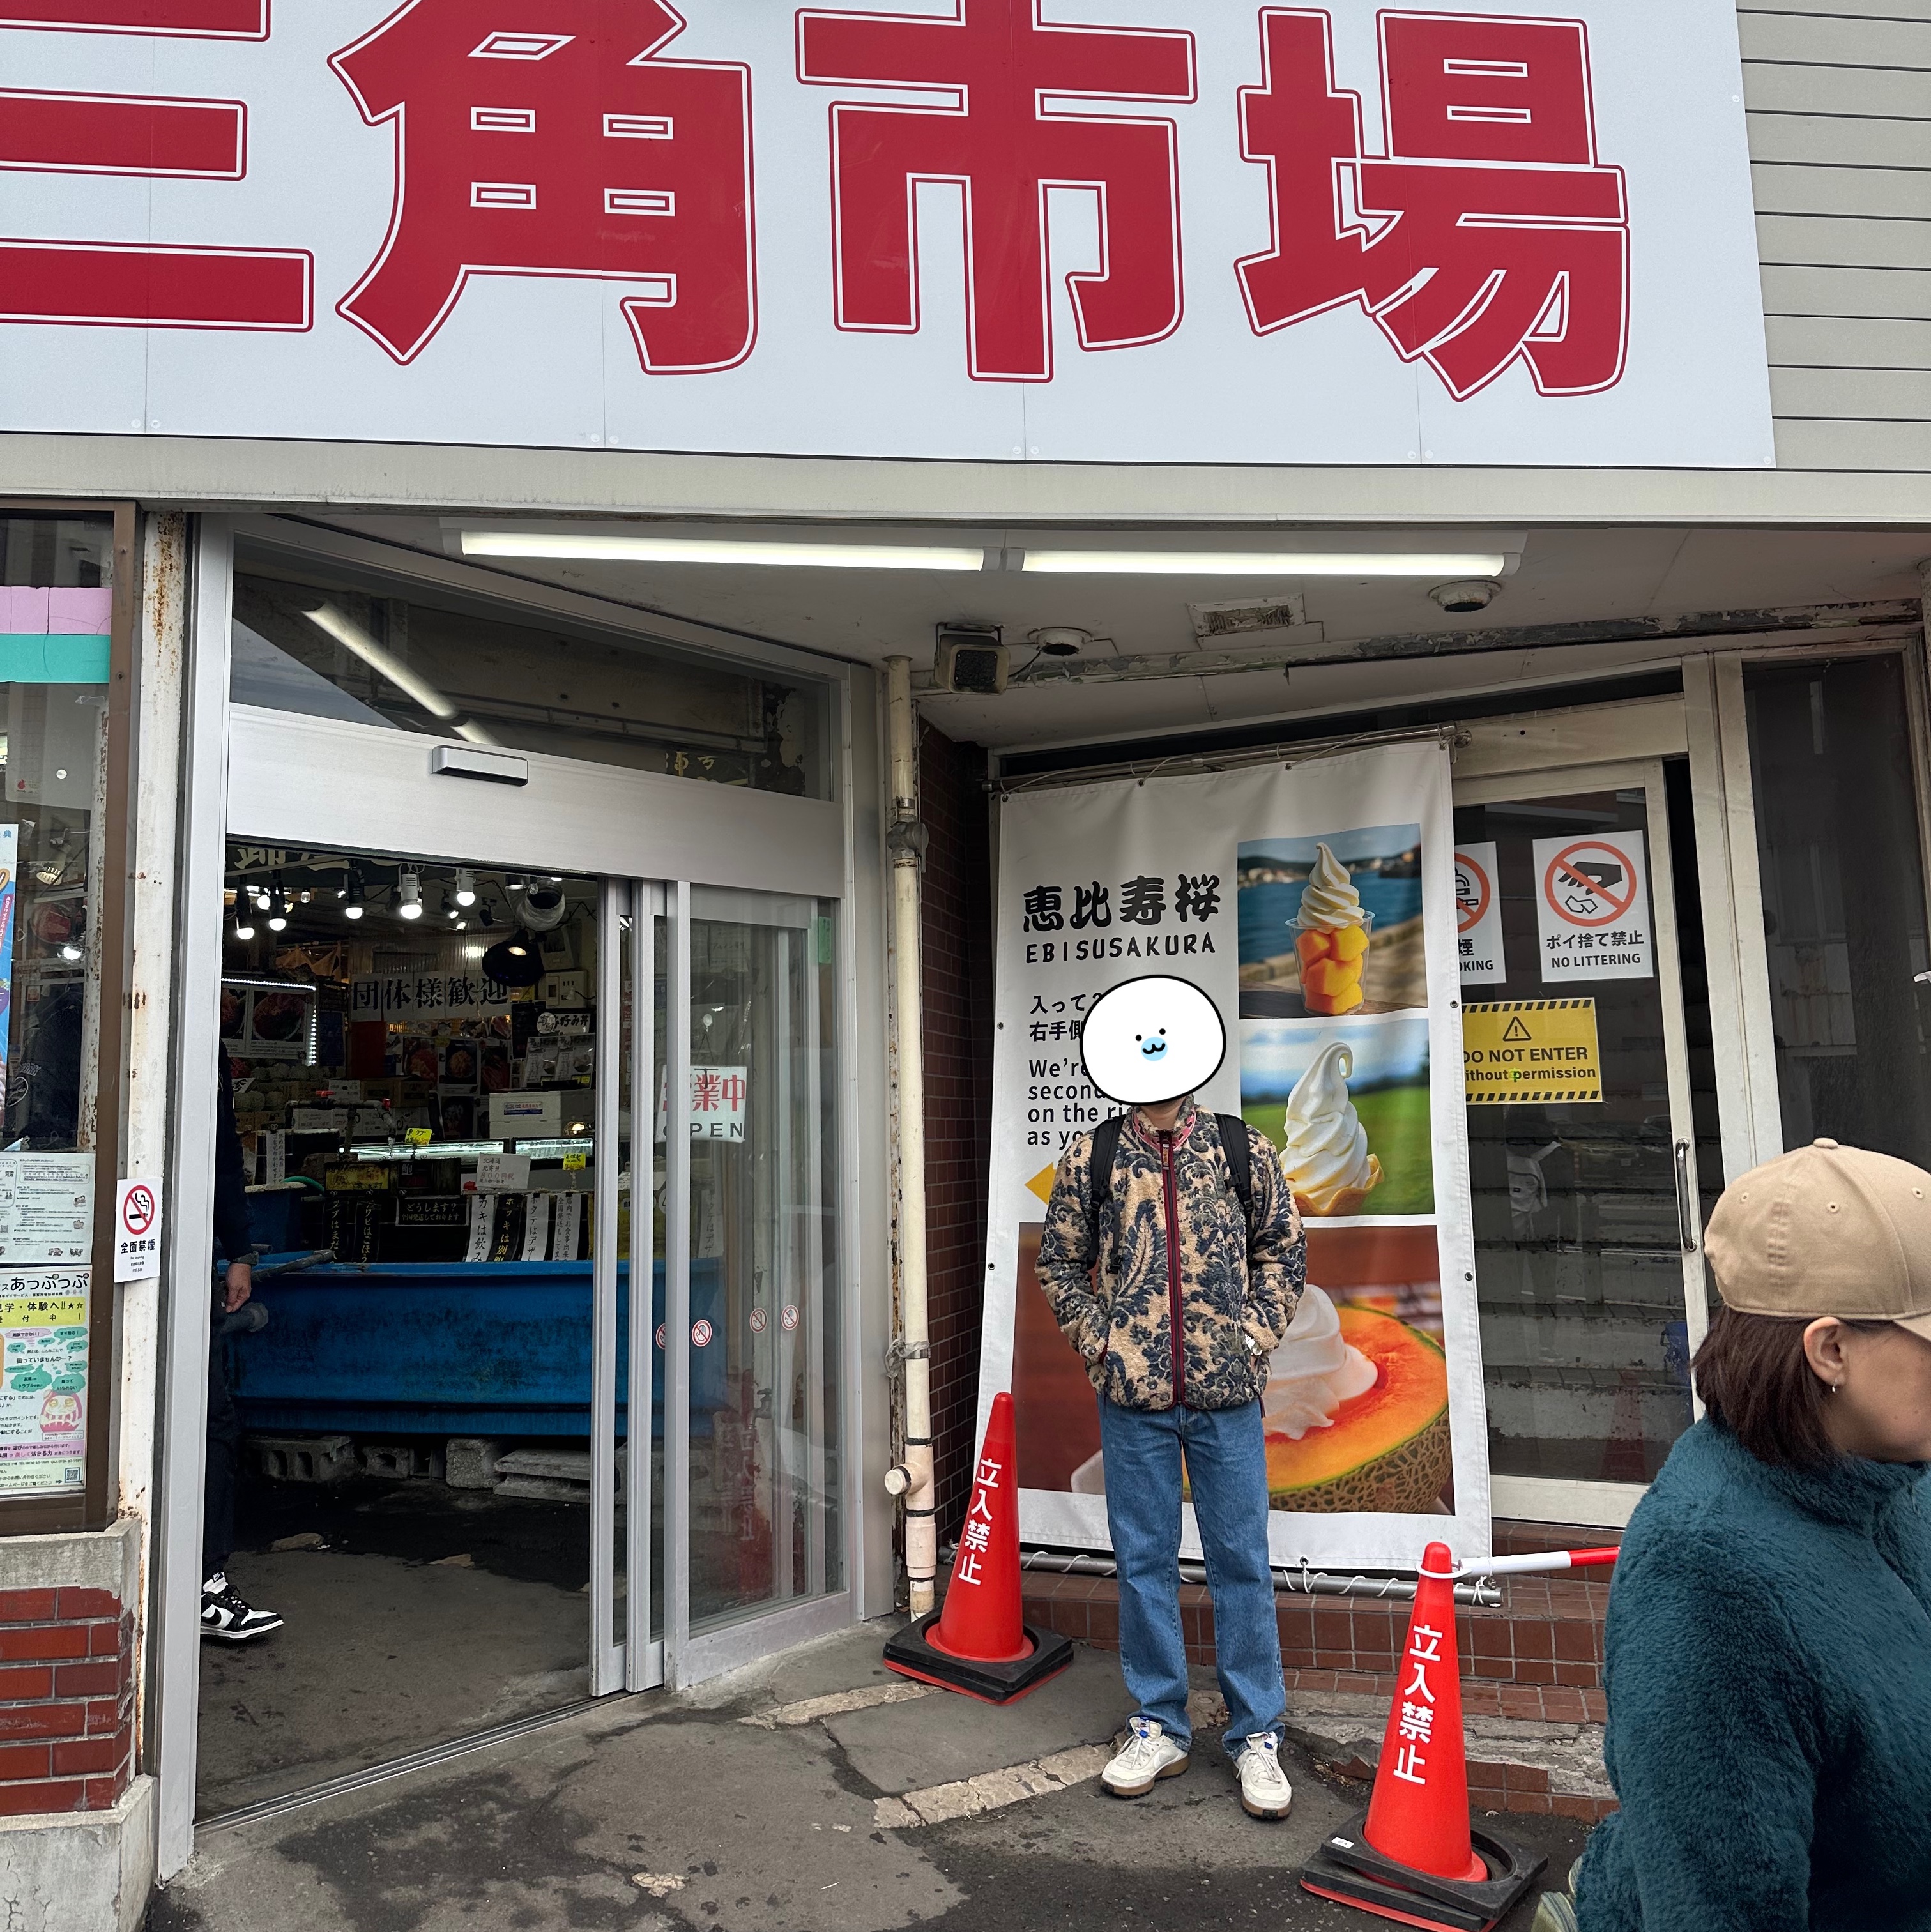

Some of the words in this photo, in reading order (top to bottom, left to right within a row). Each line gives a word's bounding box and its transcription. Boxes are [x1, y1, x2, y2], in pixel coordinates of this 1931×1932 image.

[0, 0, 1630, 402] 三角市場
[1023, 874, 1220, 933] 恵比寿桜
[1026, 932, 1216, 963] EBISUSAKURA
[1458, 939, 1474, 956] 煙
[1546, 930, 1644, 950] ポイ捨て禁止
[1552, 957, 1570, 968] NO
[1574, 953, 1640, 967] LITTERING
[353, 977, 508, 1010] 団体様歓迎
[1489, 1049, 1525, 1063] NOT
[1530, 1047, 1588, 1061] ENTER
[1513, 1067, 1596, 1082] permission
[663, 1074, 745, 1112] 業中
[1028, 1108, 1054, 1122] on
[1063, 1102, 1099, 1122] the
[663, 1123, 743, 1137] PEN
[1027, 1131, 1051, 1145] as
[555, 1196, 565, 1261] 全国発送もしてま
[563, 1197, 572, 1261] 店内でお食事出来
[120, 1238, 155, 1254] 全面禁煙
[958, 1458, 1002, 1586] 立入禁止
[1393, 1624, 1443, 1785] 立入禁止
